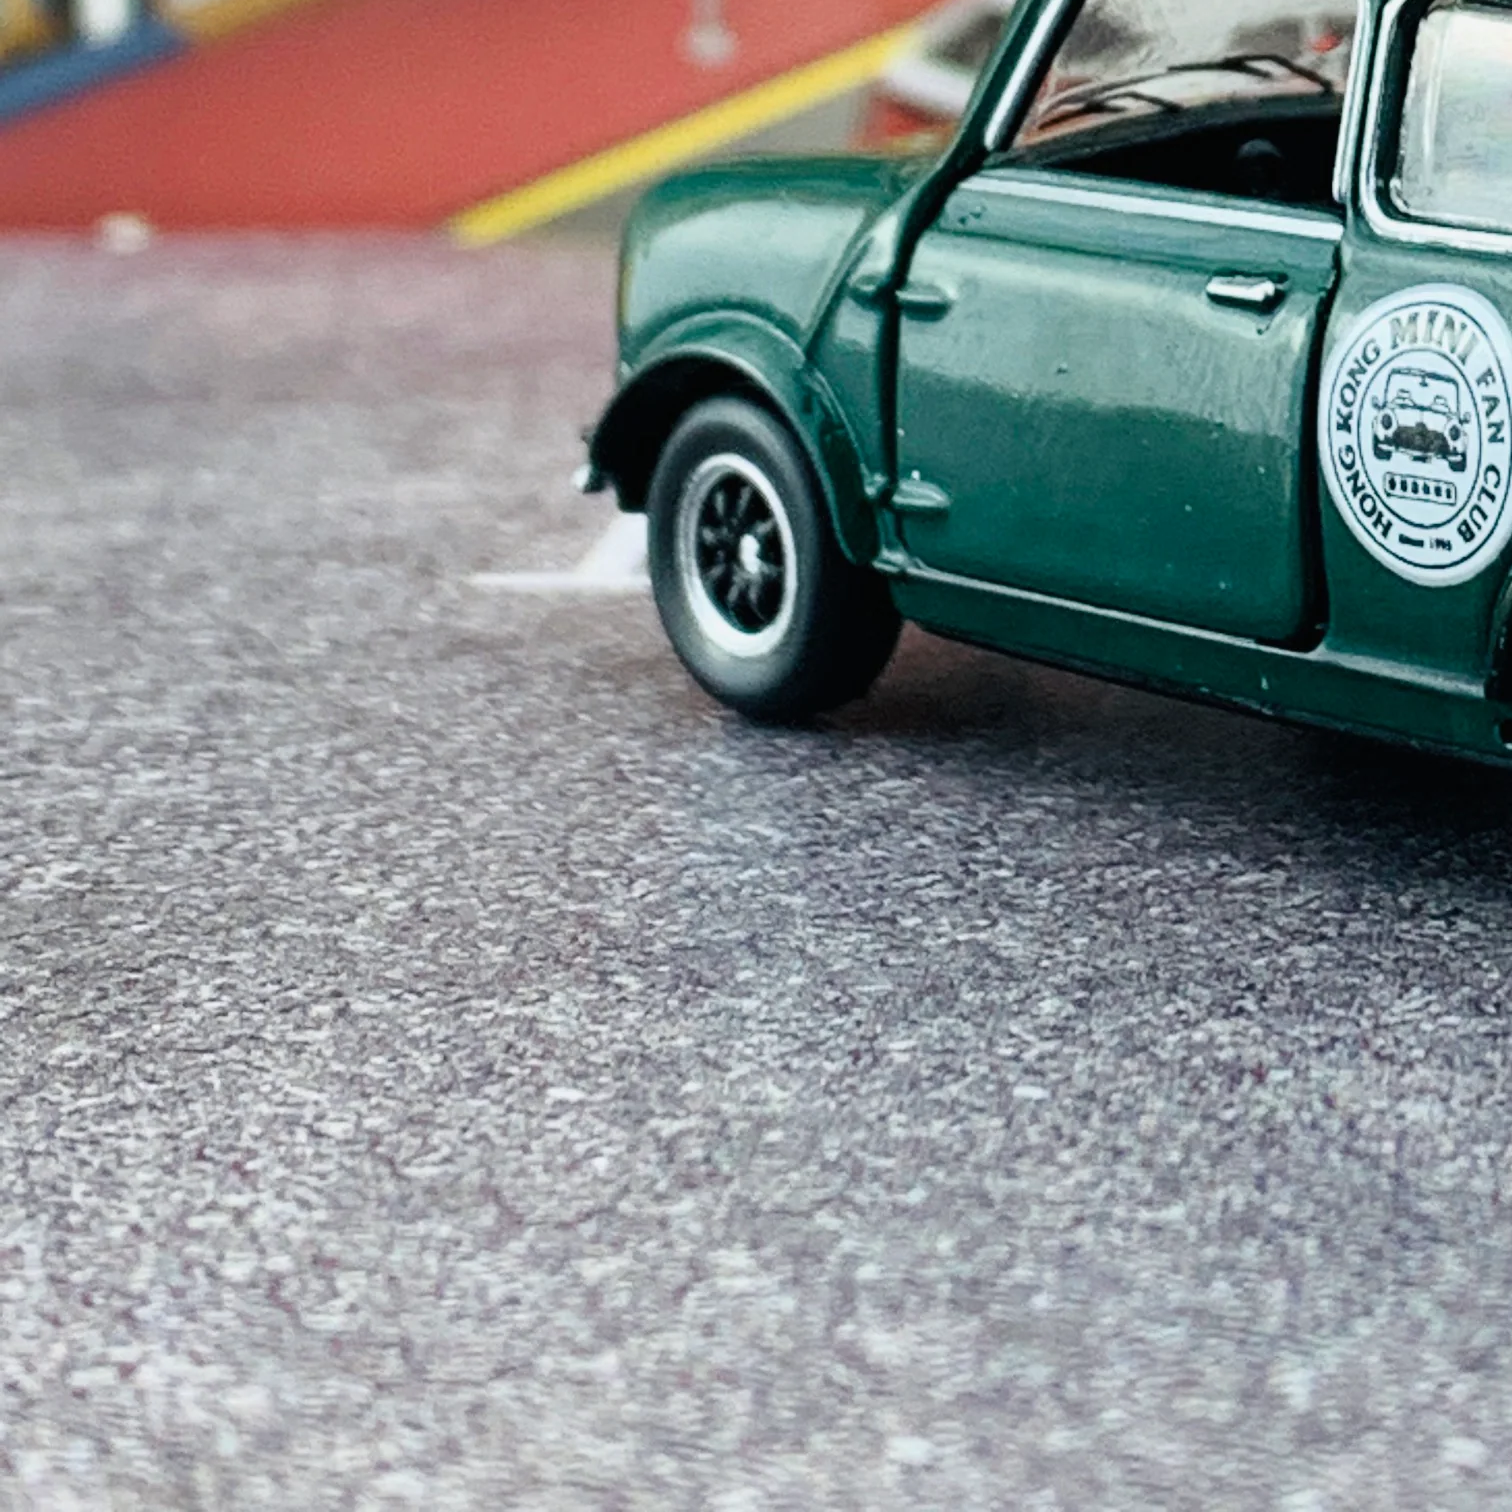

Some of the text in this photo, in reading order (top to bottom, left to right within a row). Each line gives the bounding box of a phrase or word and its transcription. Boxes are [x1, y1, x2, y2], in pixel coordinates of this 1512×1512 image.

[1336, 310, 1505, 544] HONG KONG MINI FAN CLUB
